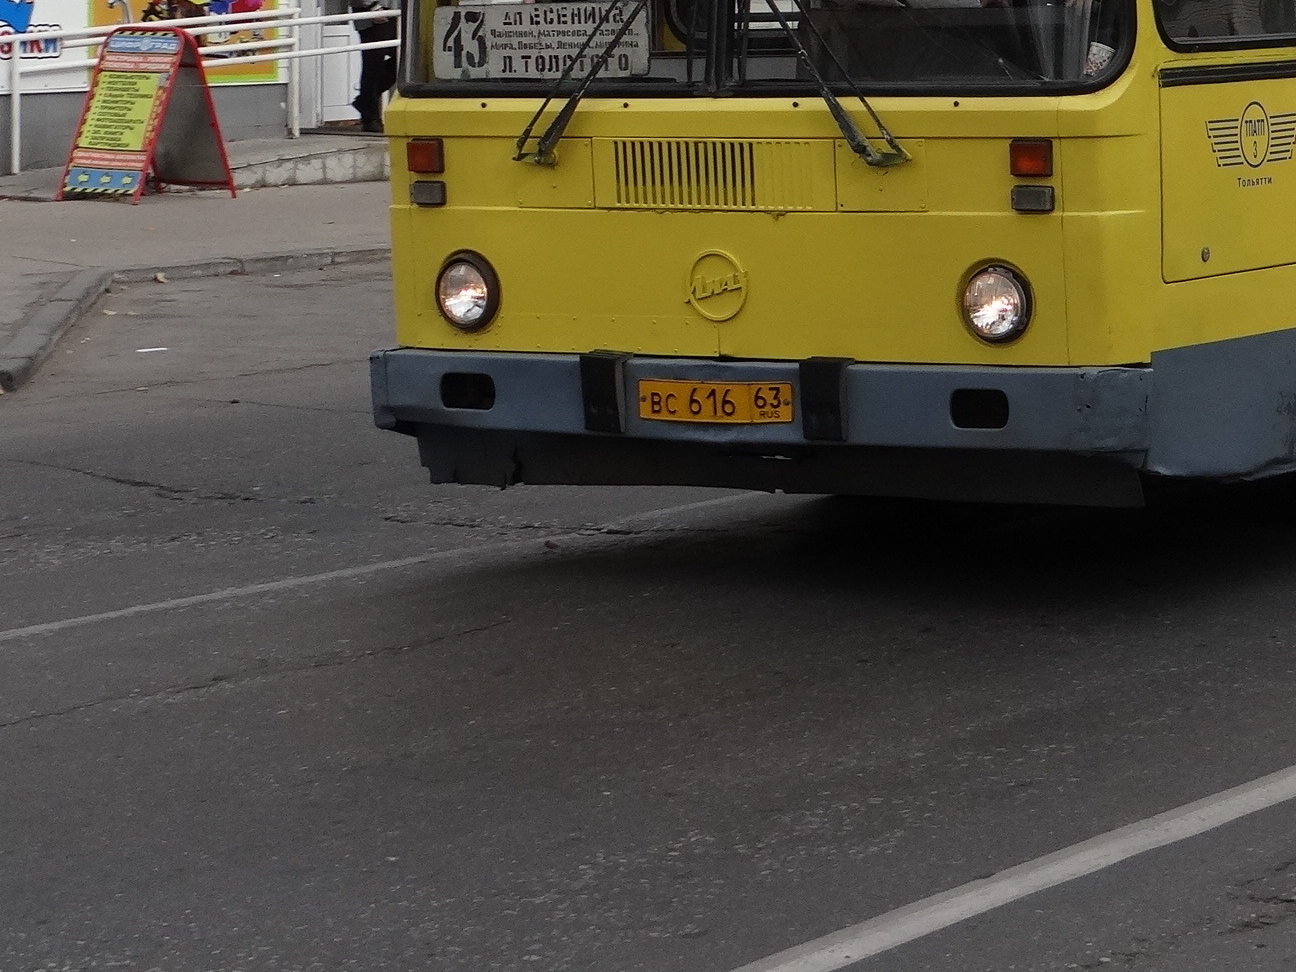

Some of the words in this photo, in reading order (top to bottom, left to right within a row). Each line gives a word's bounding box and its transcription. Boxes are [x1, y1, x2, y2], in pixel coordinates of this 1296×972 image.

[442, 11, 488, 69] 43
[1252, 140, 1258, 159] 3
[1237, 176, 1273, 188] Тольятти
[688, 387, 736, 417] 616
[754, 385, 782, 409] 63
[758, 410, 781, 419] RUS
